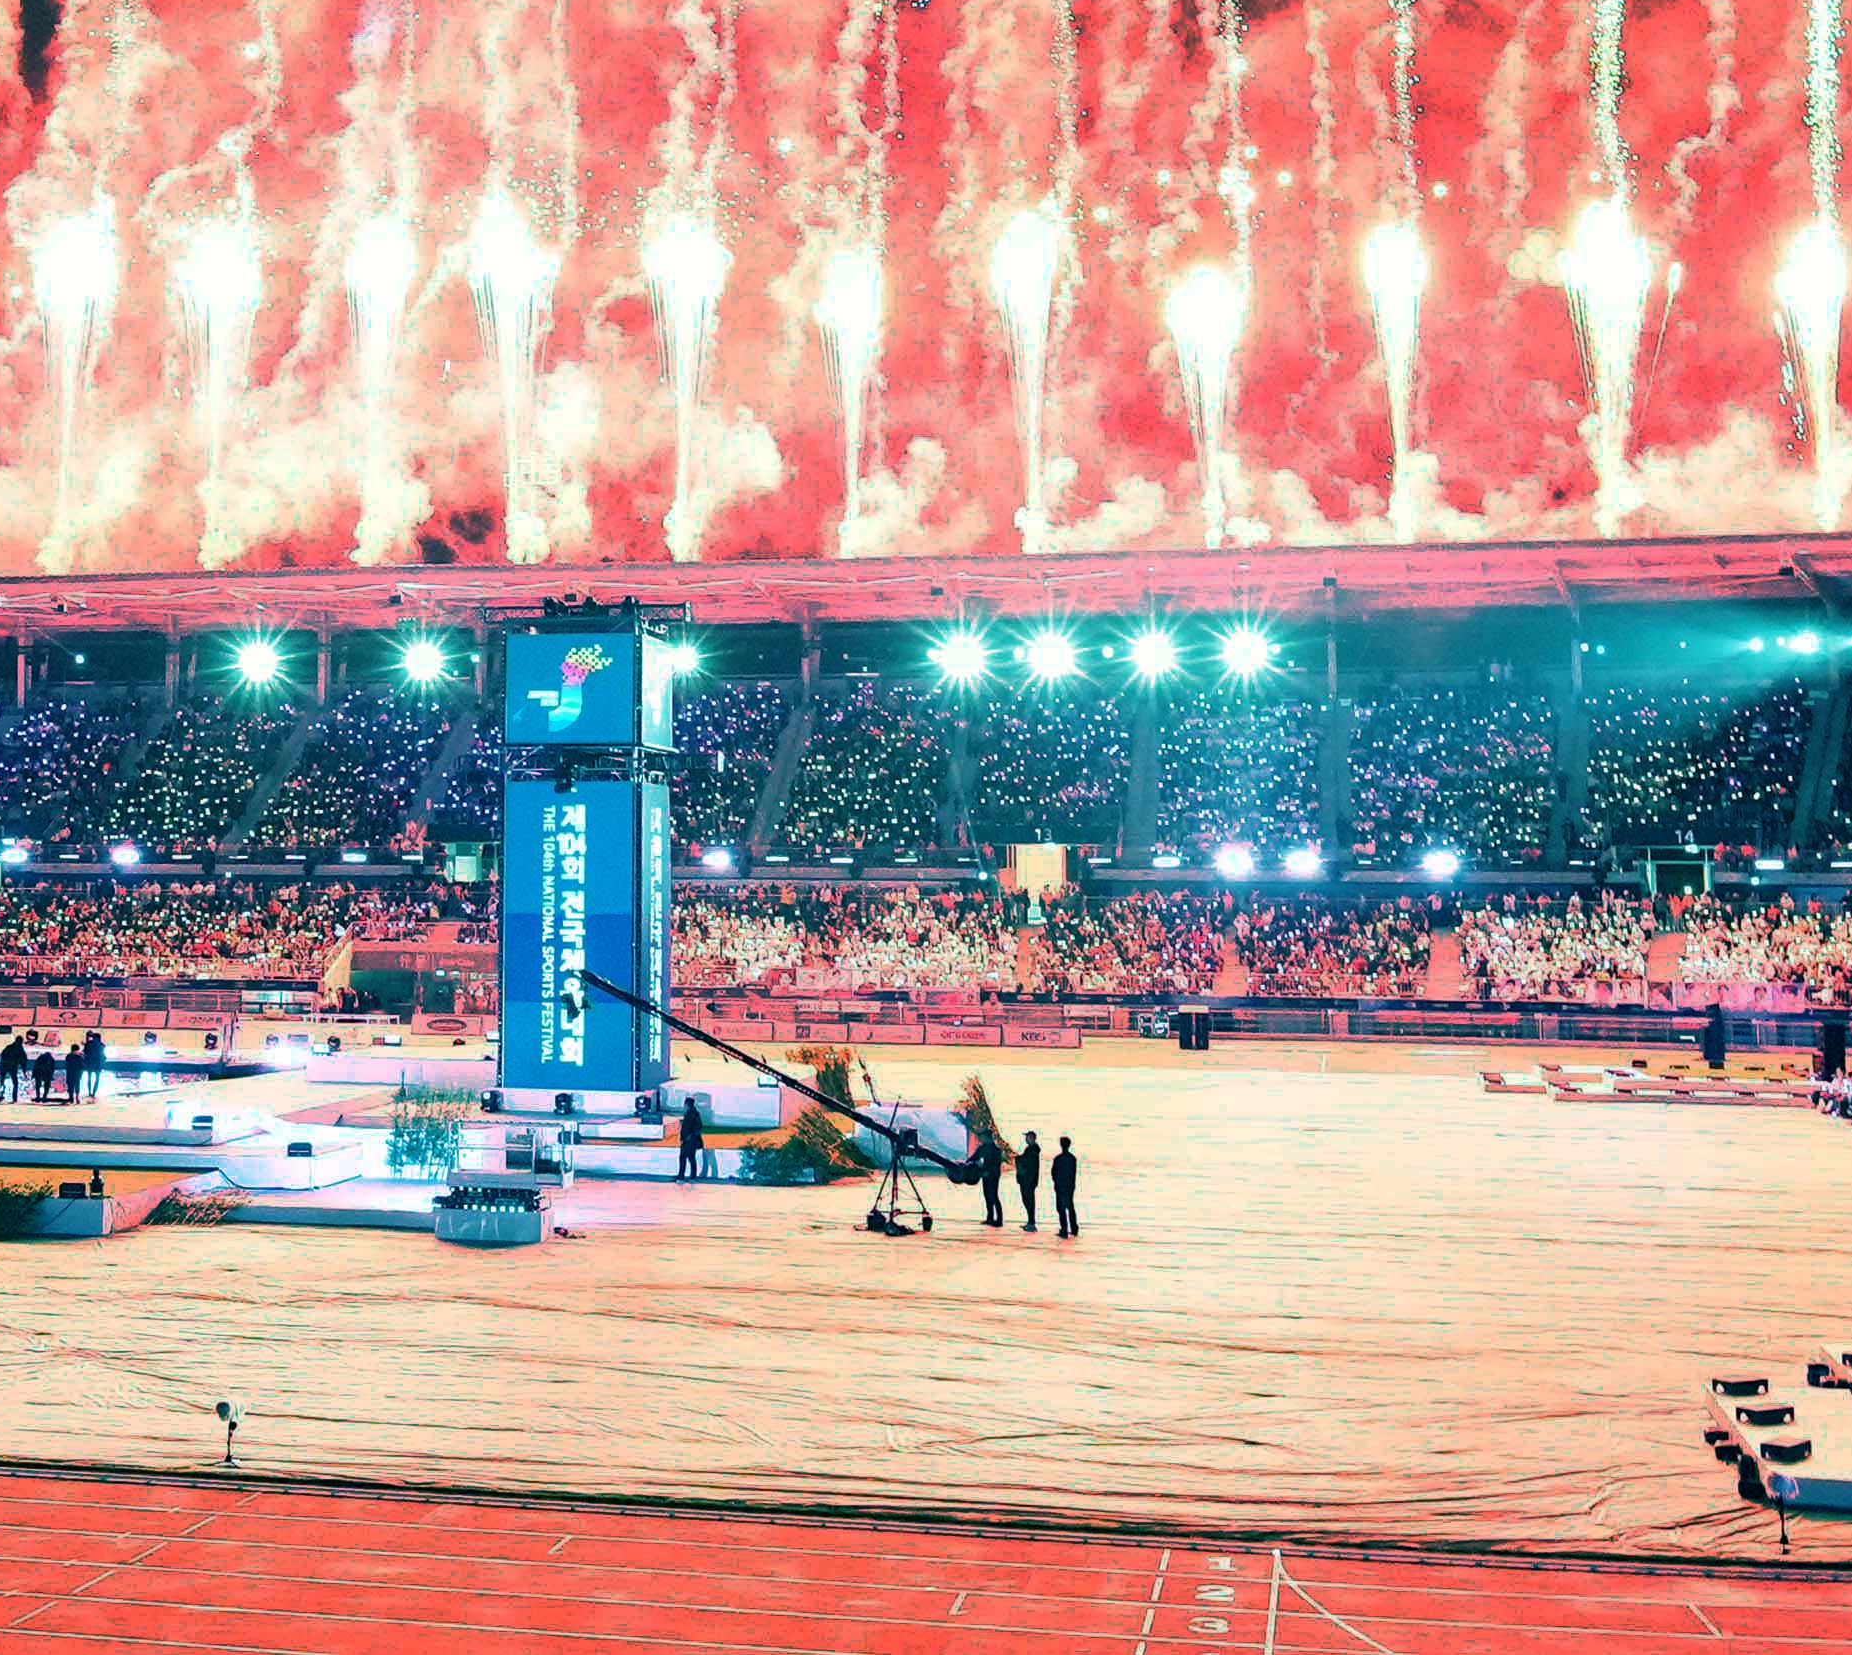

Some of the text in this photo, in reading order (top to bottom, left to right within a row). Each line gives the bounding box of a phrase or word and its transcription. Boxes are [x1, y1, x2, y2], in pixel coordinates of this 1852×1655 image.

[1035, 828, 1052, 842] 13
[1675, 829, 1694, 844] 14
[541, 805, 556, 1064] THE 104th NATIONAL SPORTS FESTIVAL
[1187, 1616, 1231, 1634] 3
